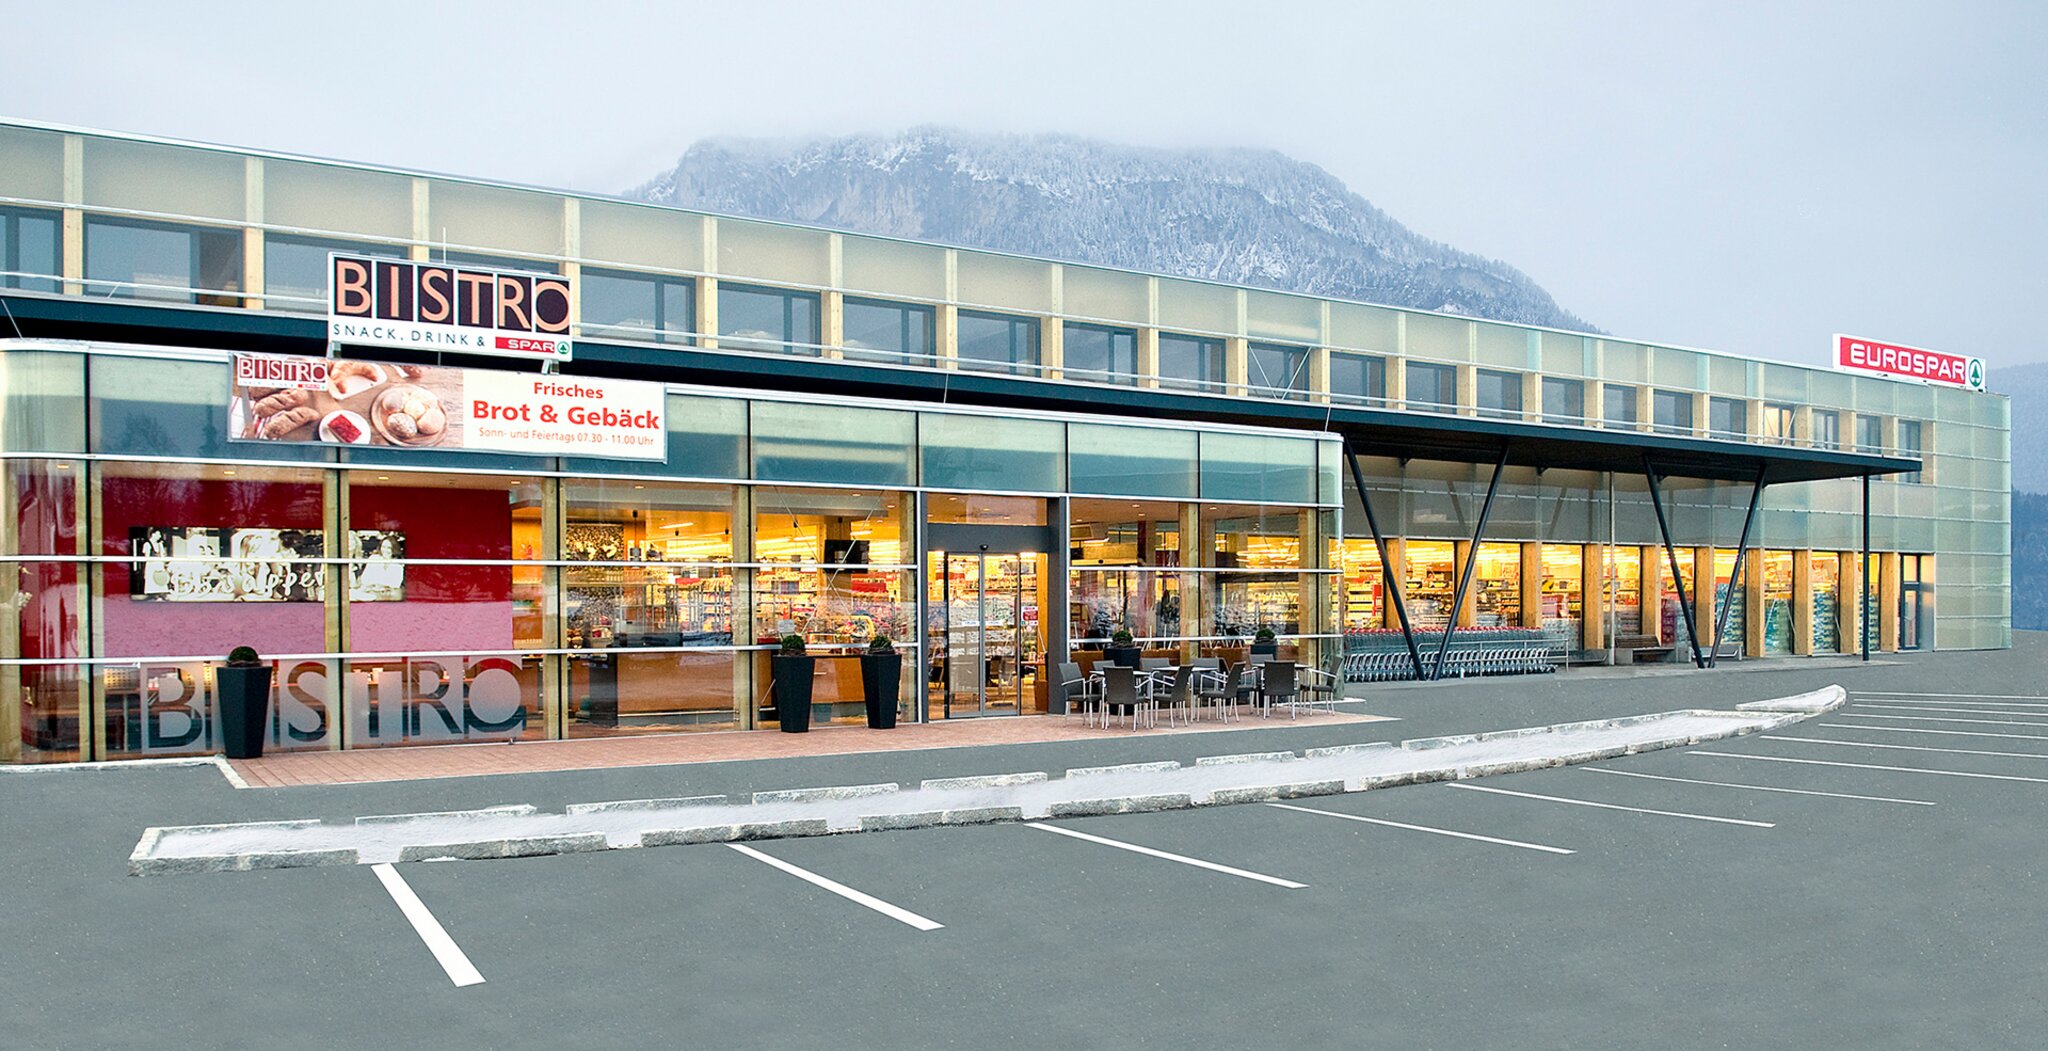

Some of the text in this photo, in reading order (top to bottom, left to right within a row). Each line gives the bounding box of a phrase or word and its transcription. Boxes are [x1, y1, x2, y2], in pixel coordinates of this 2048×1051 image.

[336, 260, 570, 332] BISTRO
[411, 330, 469, 346] DRINK
[477, 337, 486, 347] &
[507, 339, 555, 352] SPAR
[239, 357, 327, 382] BISTRO
[1850, 342, 1965, 381] EUROSPAR
[533, 381, 604, 399] Frisches
[473, 400, 660, 430] Brot & Gebäck
[479, 426, 508, 438] Sonn-
[510, 428, 530, 439] und
[532, 430, 575, 443] Feiertags
[577, 432, 602, 443] 07.30
[611, 434, 636, 445] 11.00
[638, 435, 654, 446] Uhr
[148, 658, 527, 748] BSTRO
